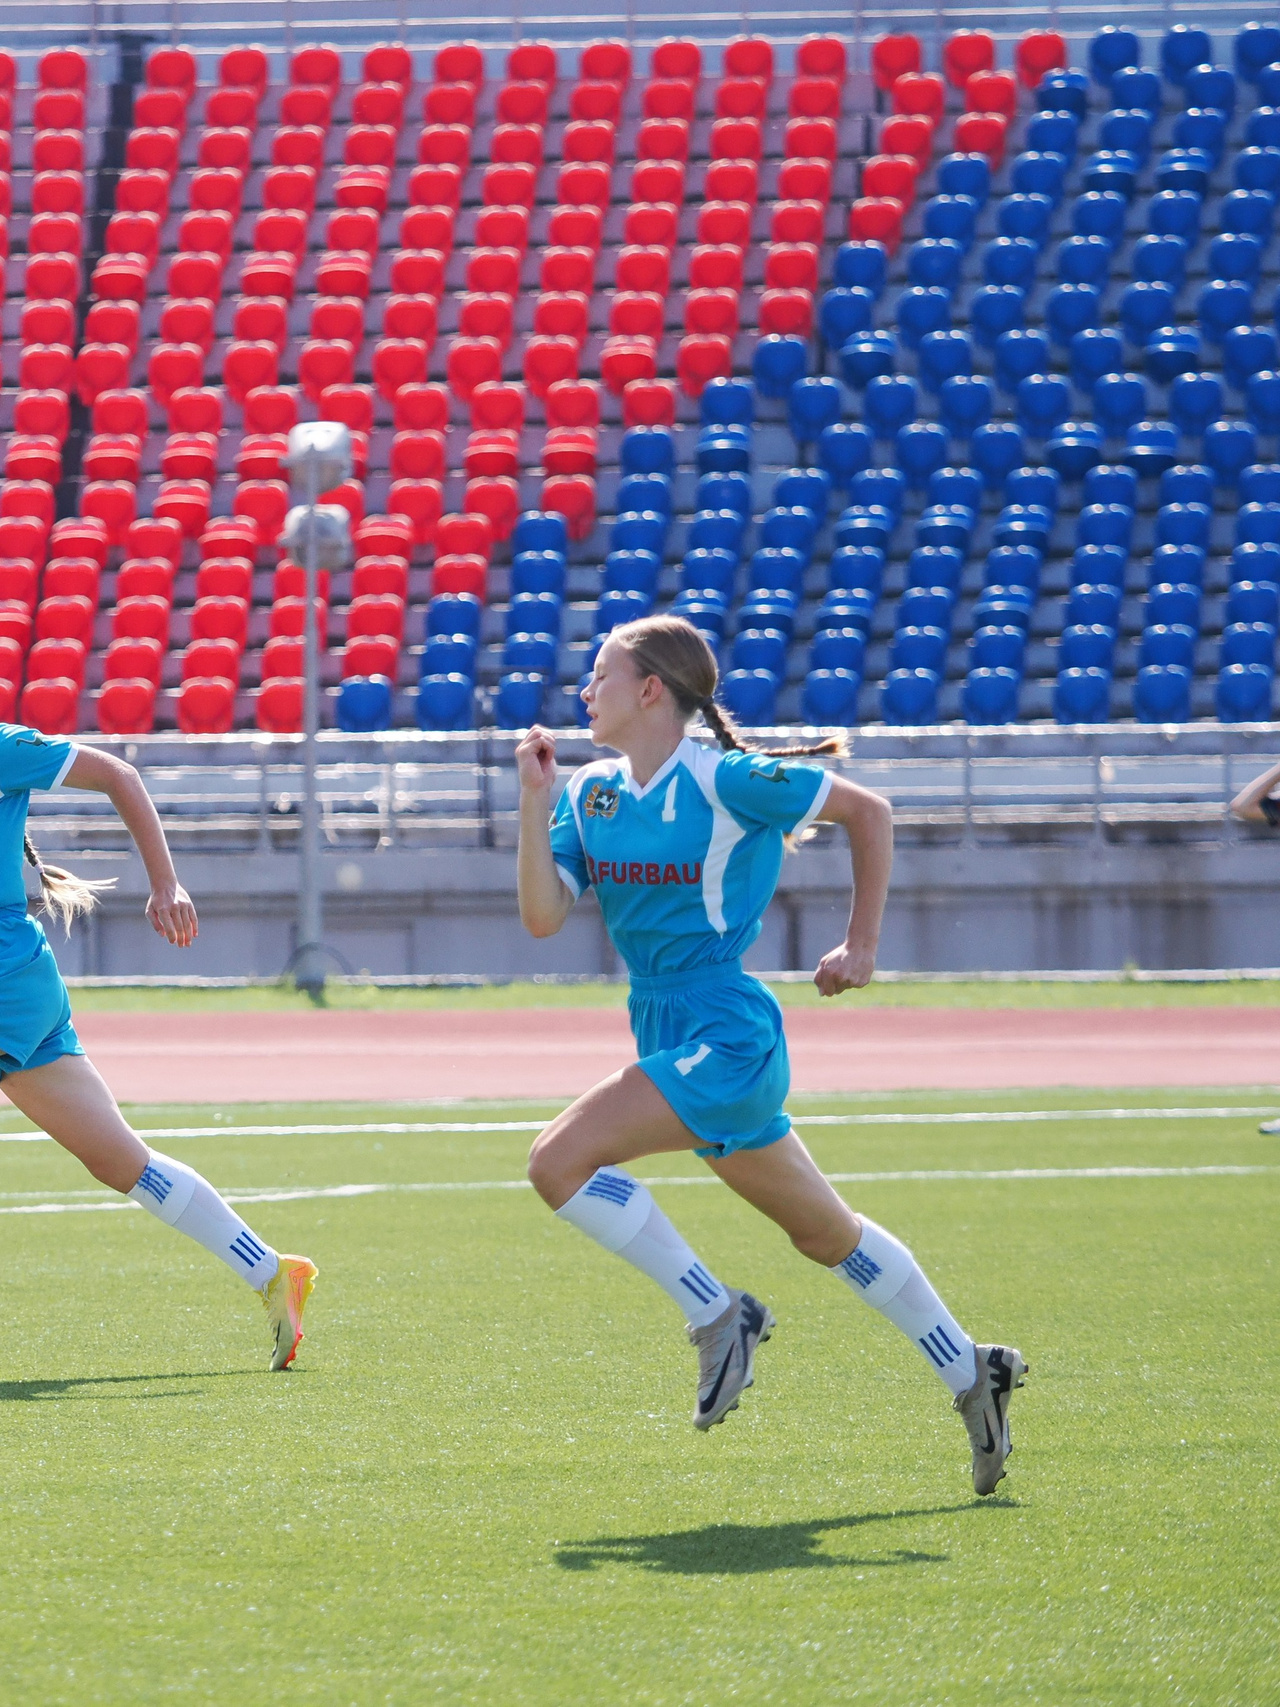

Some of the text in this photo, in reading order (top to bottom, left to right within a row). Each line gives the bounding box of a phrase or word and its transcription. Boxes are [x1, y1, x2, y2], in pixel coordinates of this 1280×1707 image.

[661, 775, 678, 822] 1
[598, 861, 702, 885] FURBAU
[674, 1043, 712, 1076] 1
